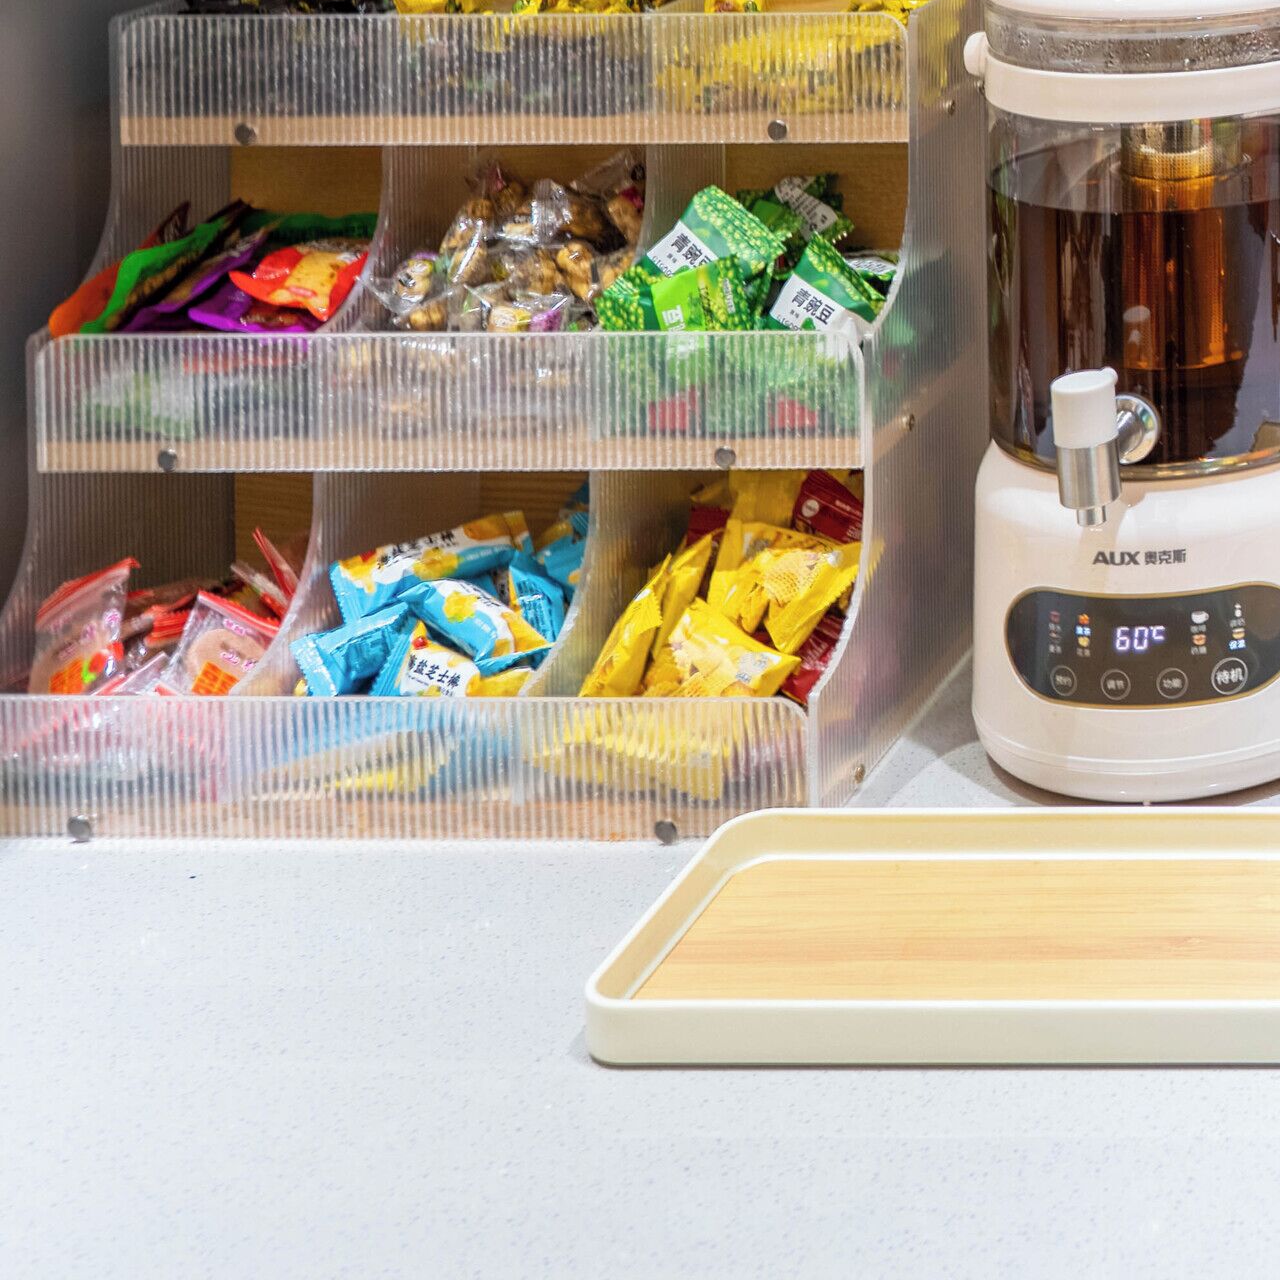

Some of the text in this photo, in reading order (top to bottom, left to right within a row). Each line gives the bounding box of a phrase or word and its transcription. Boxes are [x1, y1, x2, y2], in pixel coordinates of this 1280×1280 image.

[792, 288, 835, 326] 青豌豆
[1092, 548, 1187, 566] AUX 奥克斯
[1216, 667, 1245, 686] 待机
